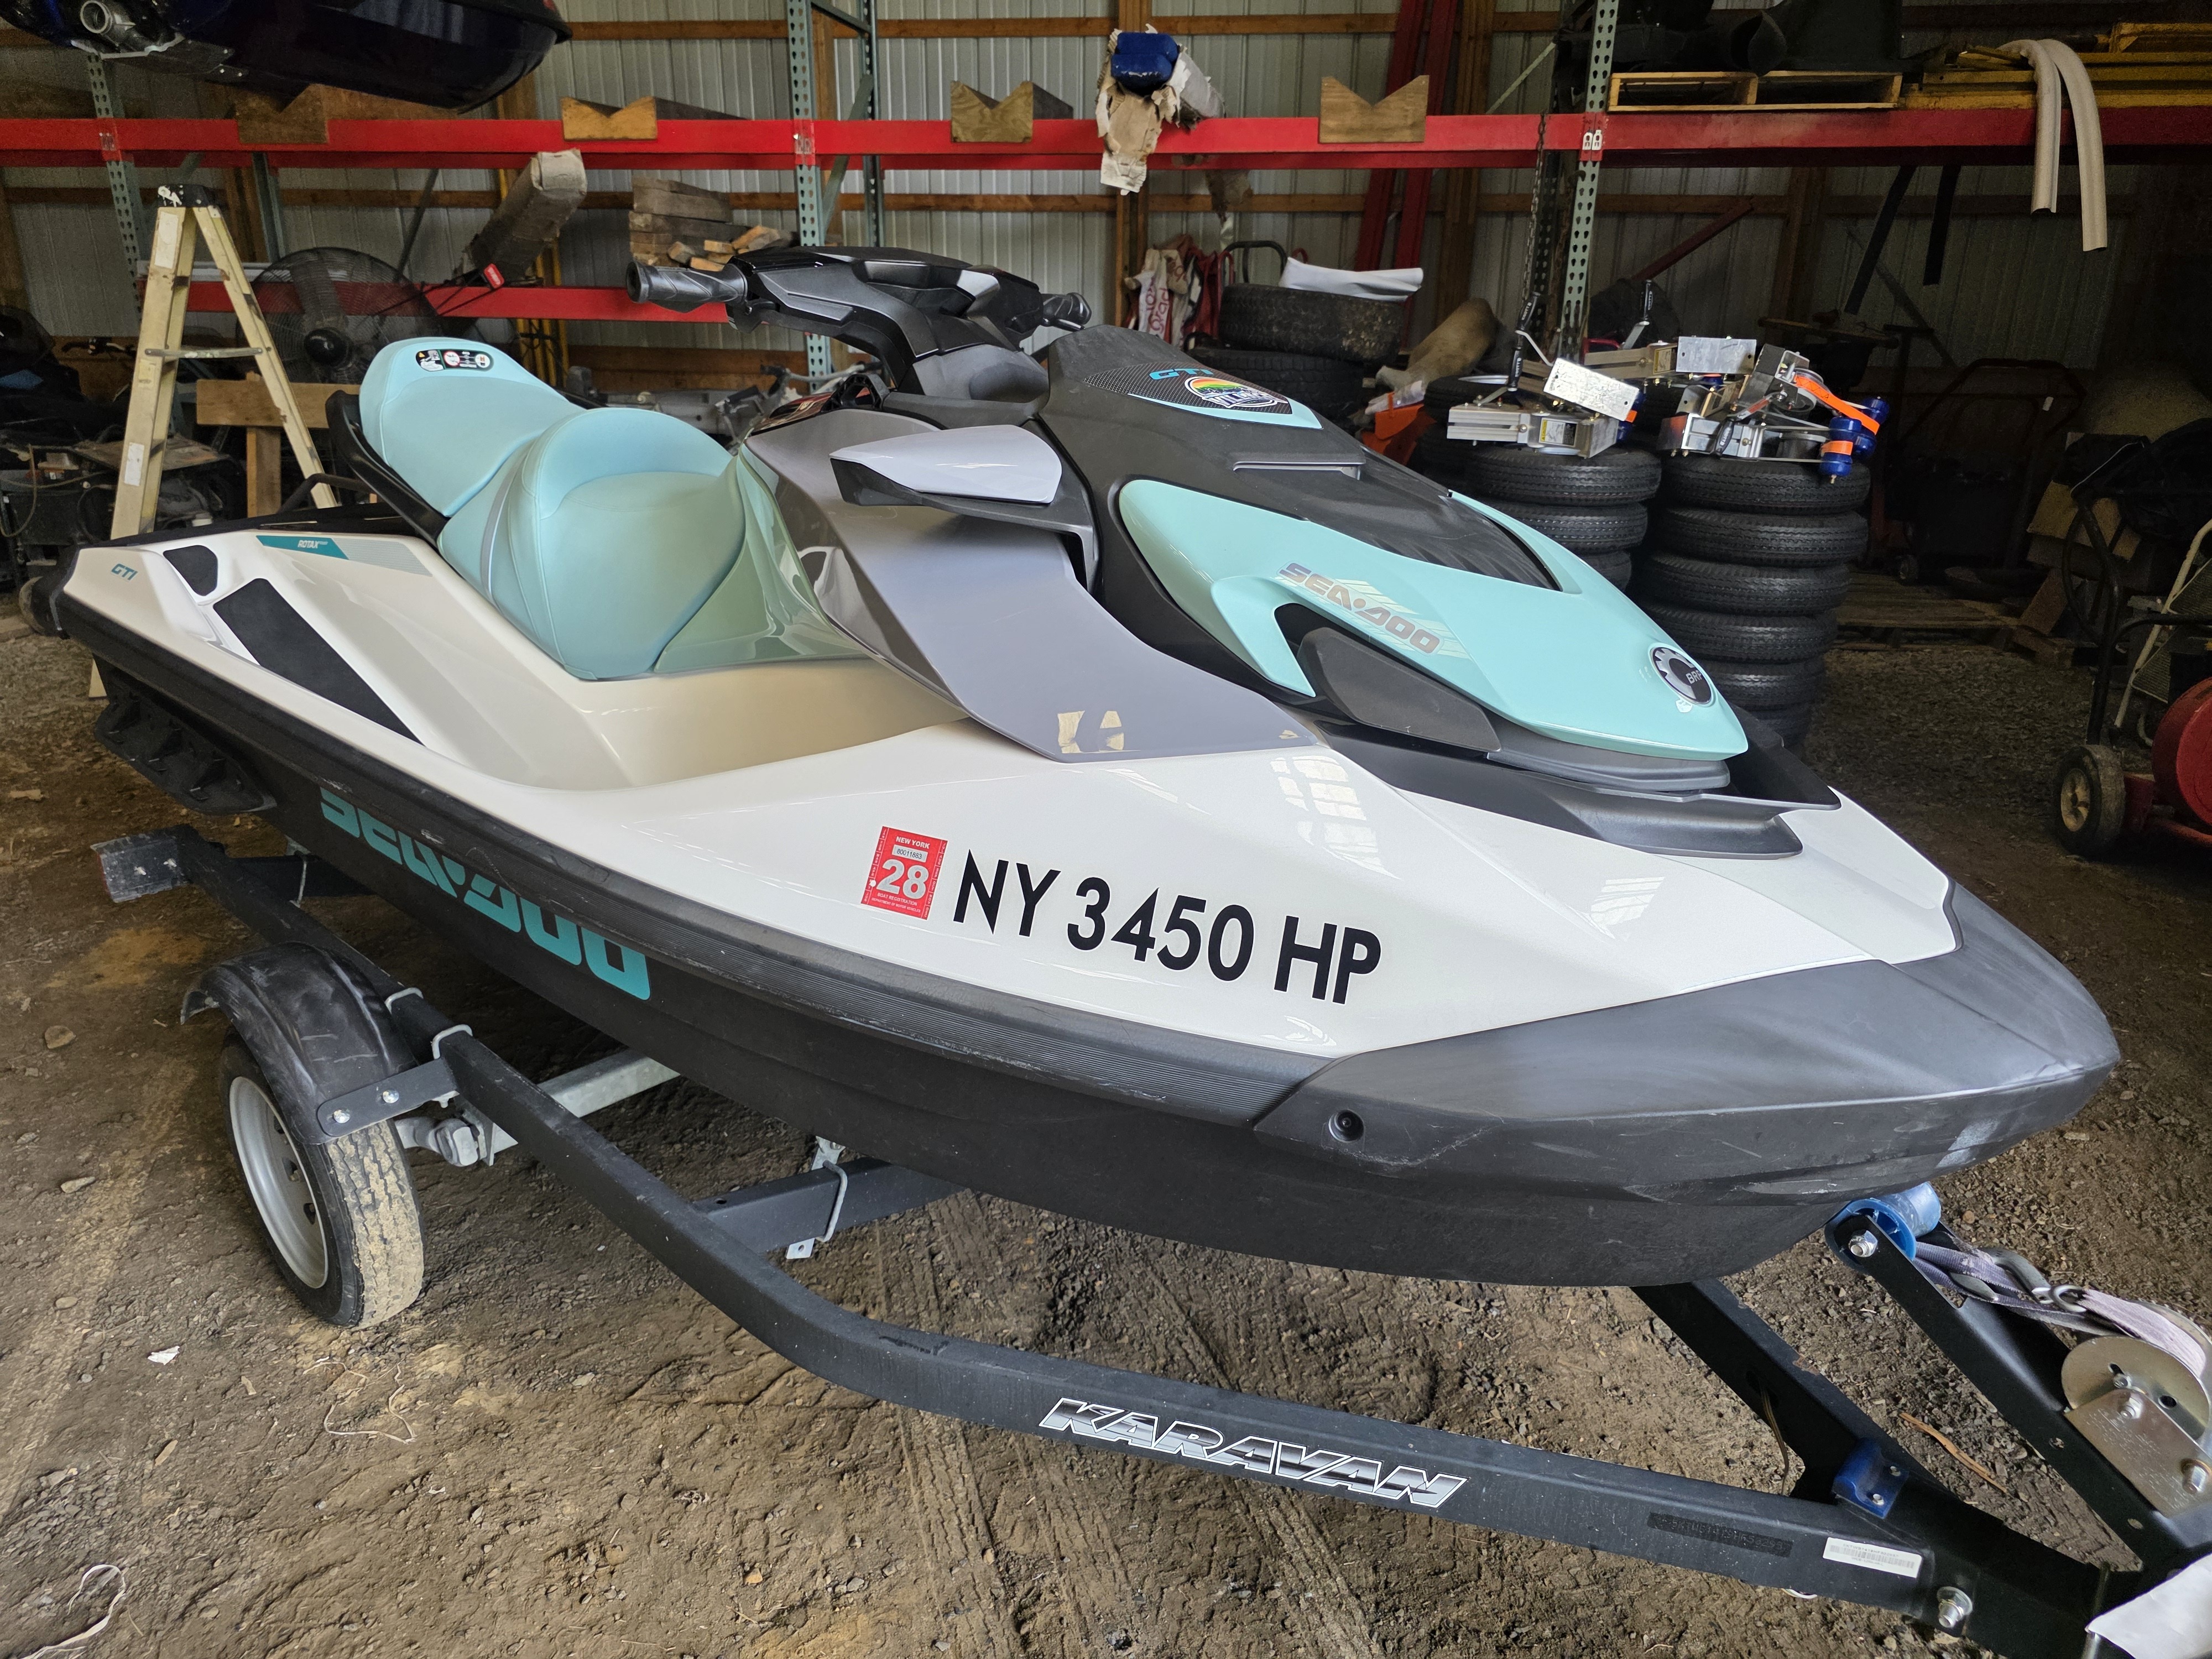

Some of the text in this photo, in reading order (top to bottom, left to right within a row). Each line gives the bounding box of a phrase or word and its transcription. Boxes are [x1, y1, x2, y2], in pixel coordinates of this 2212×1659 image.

[1149, 368, 1214, 380] GTI
[298, 540, 319, 549] ROTAX
[111, 563, 138, 581] GTI
[895, 836, 931, 849] NEW YORK
[896, 848, 922, 859] 80011883
[876, 859, 930, 900] 28
[889, 895, 918, 906] REGISTRATION
[953, 848, 1381, 1005] NY 3450 HP
[1039, 1397, 1469, 1509] KARAVAN
